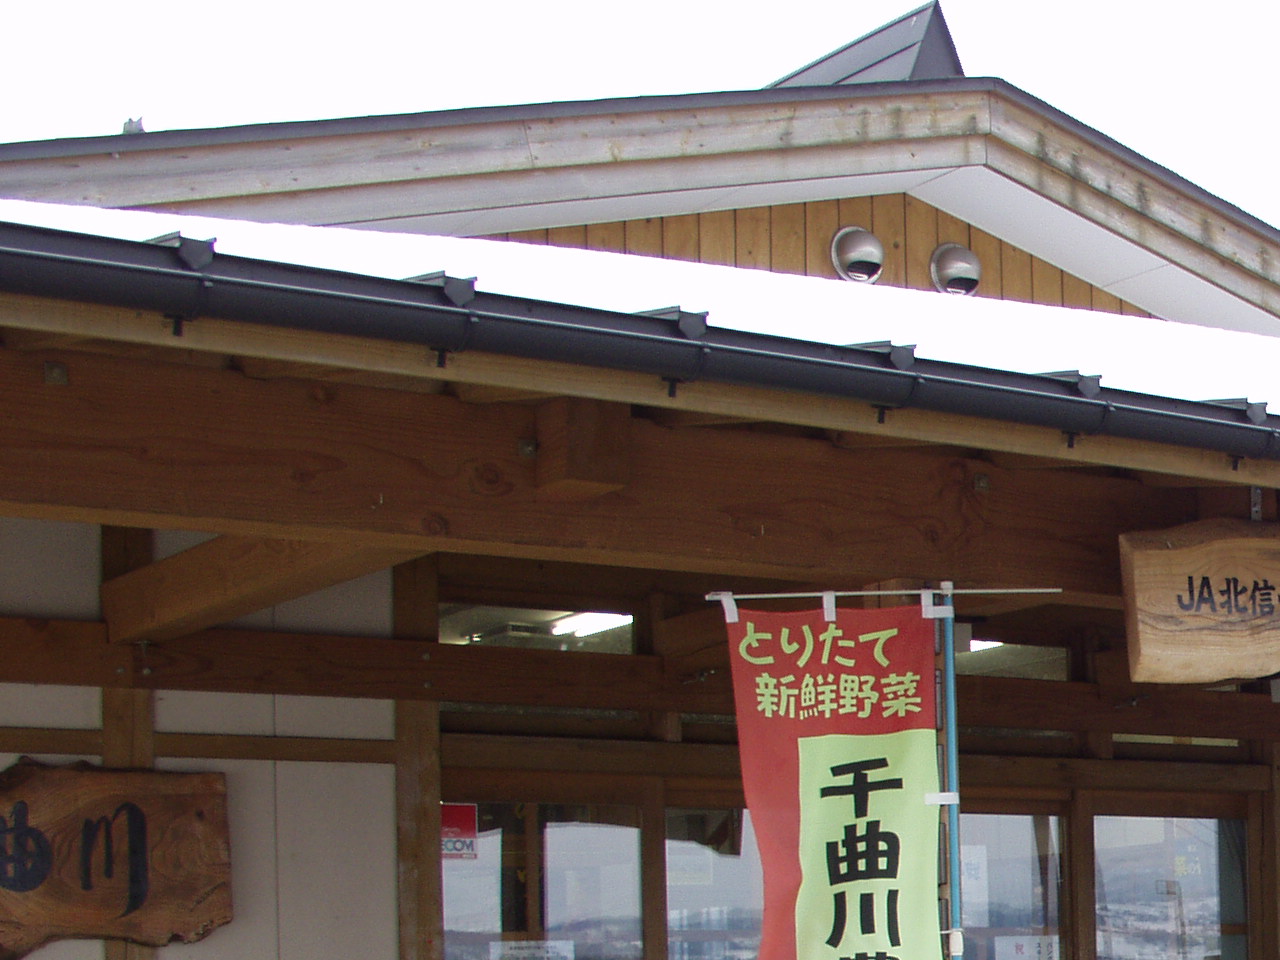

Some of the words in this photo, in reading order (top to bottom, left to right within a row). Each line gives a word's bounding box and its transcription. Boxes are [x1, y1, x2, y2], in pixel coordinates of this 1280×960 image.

[739, 622, 899, 667] とりたて
[755, 672, 923, 720] 新鮮野菜
